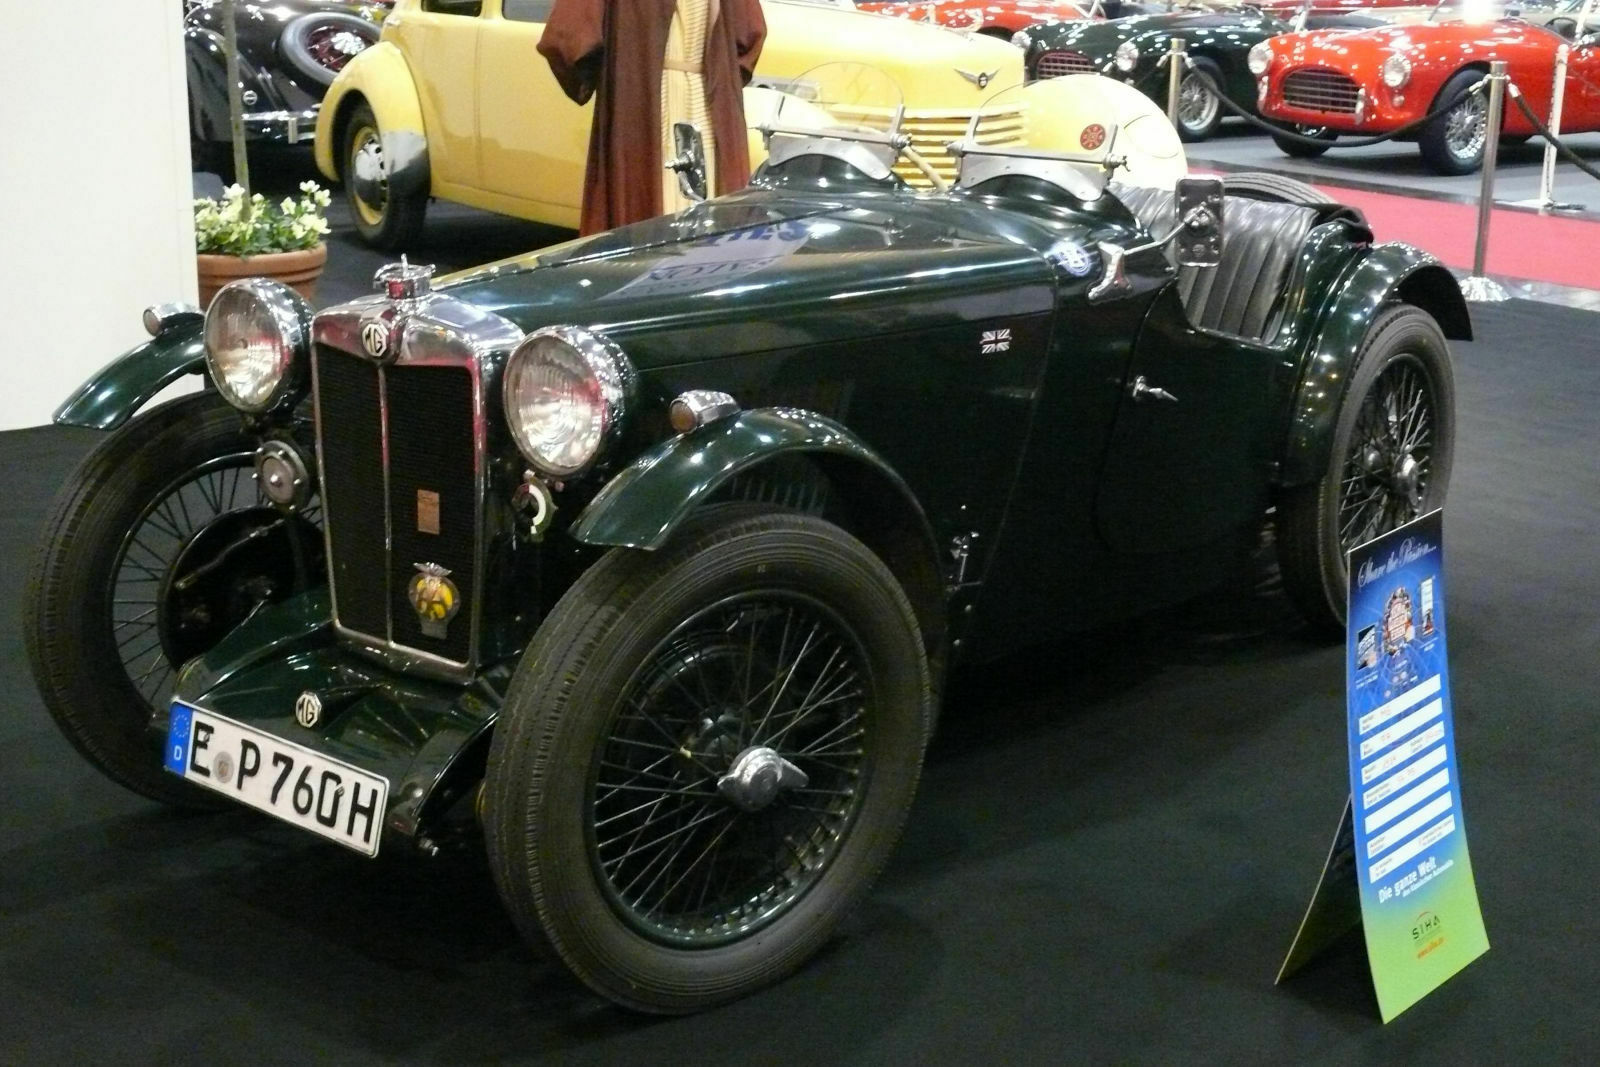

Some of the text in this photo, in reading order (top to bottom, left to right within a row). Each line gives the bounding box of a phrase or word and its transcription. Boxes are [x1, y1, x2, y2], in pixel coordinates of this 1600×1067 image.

[363, 325, 386, 355] MG
[297, 694, 317, 726] MG
[173, 745, 183, 761] D
